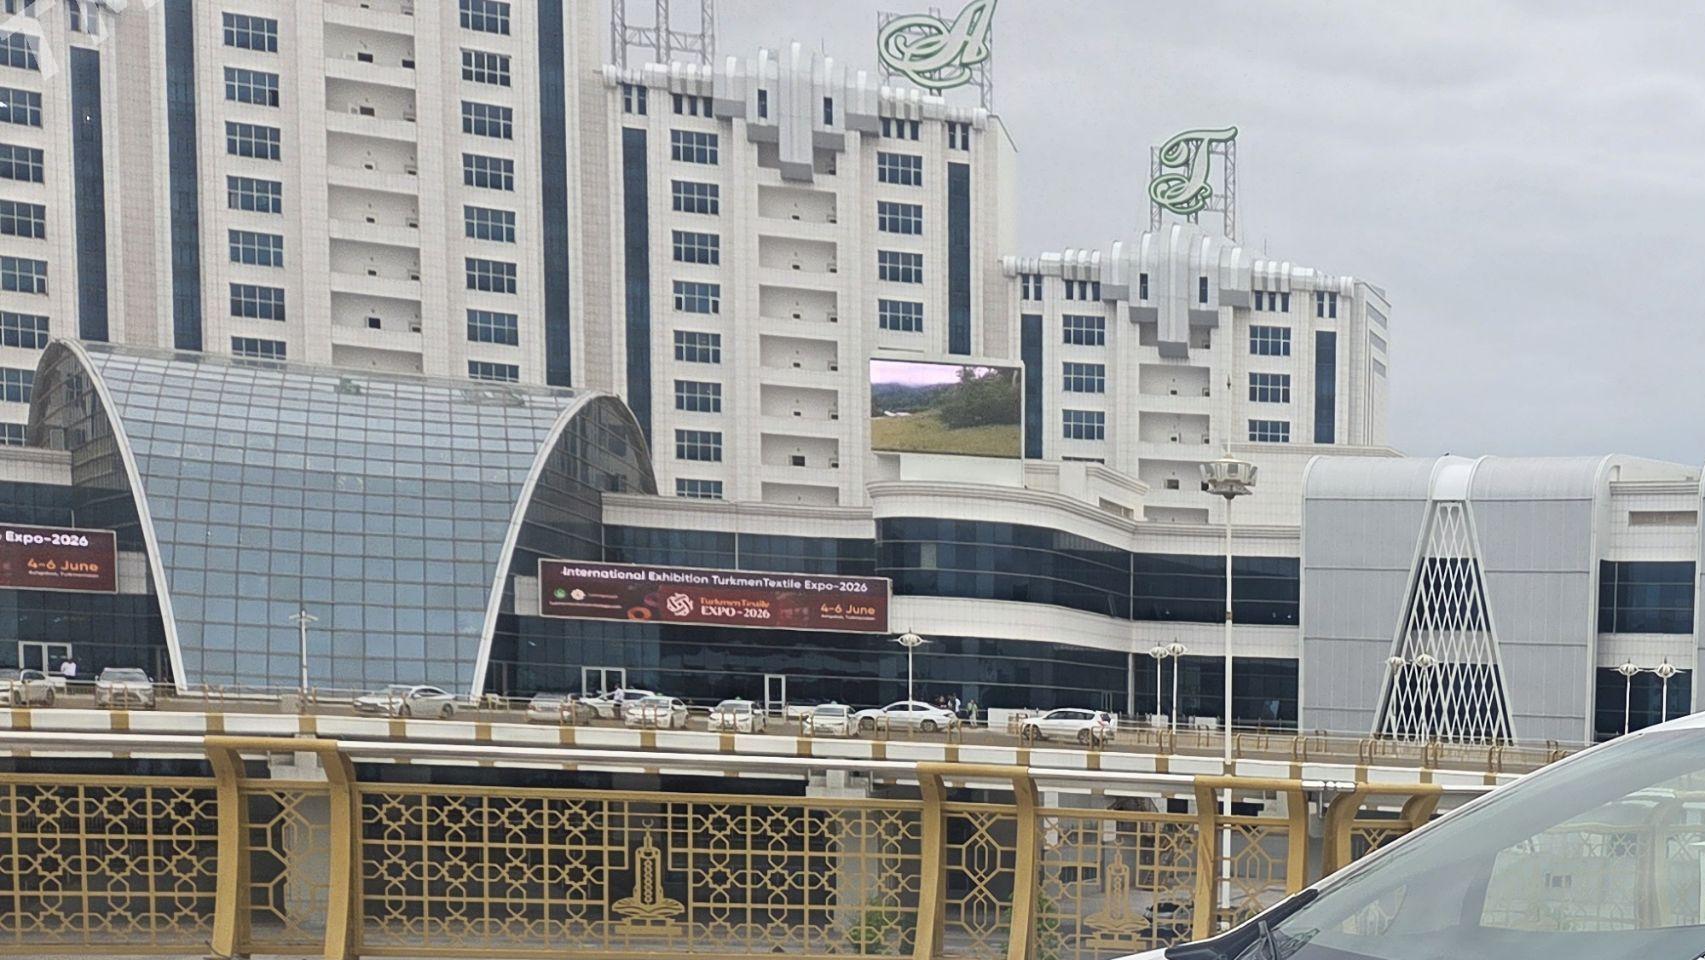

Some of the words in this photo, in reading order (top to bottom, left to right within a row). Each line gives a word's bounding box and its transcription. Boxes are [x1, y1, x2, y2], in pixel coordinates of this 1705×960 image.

[5, 530, 89, 548] Expo-2026
[27, 558, 57, 570] 4-6
[60, 560, 99, 571] June
[561, 566, 646, 581] International
[648, 571, 709, 585] Exhibition
[804, 580, 869, 593] Expo-2026
[820, 603, 843, 614] 4-6
[845, 604, 876, 615] June
